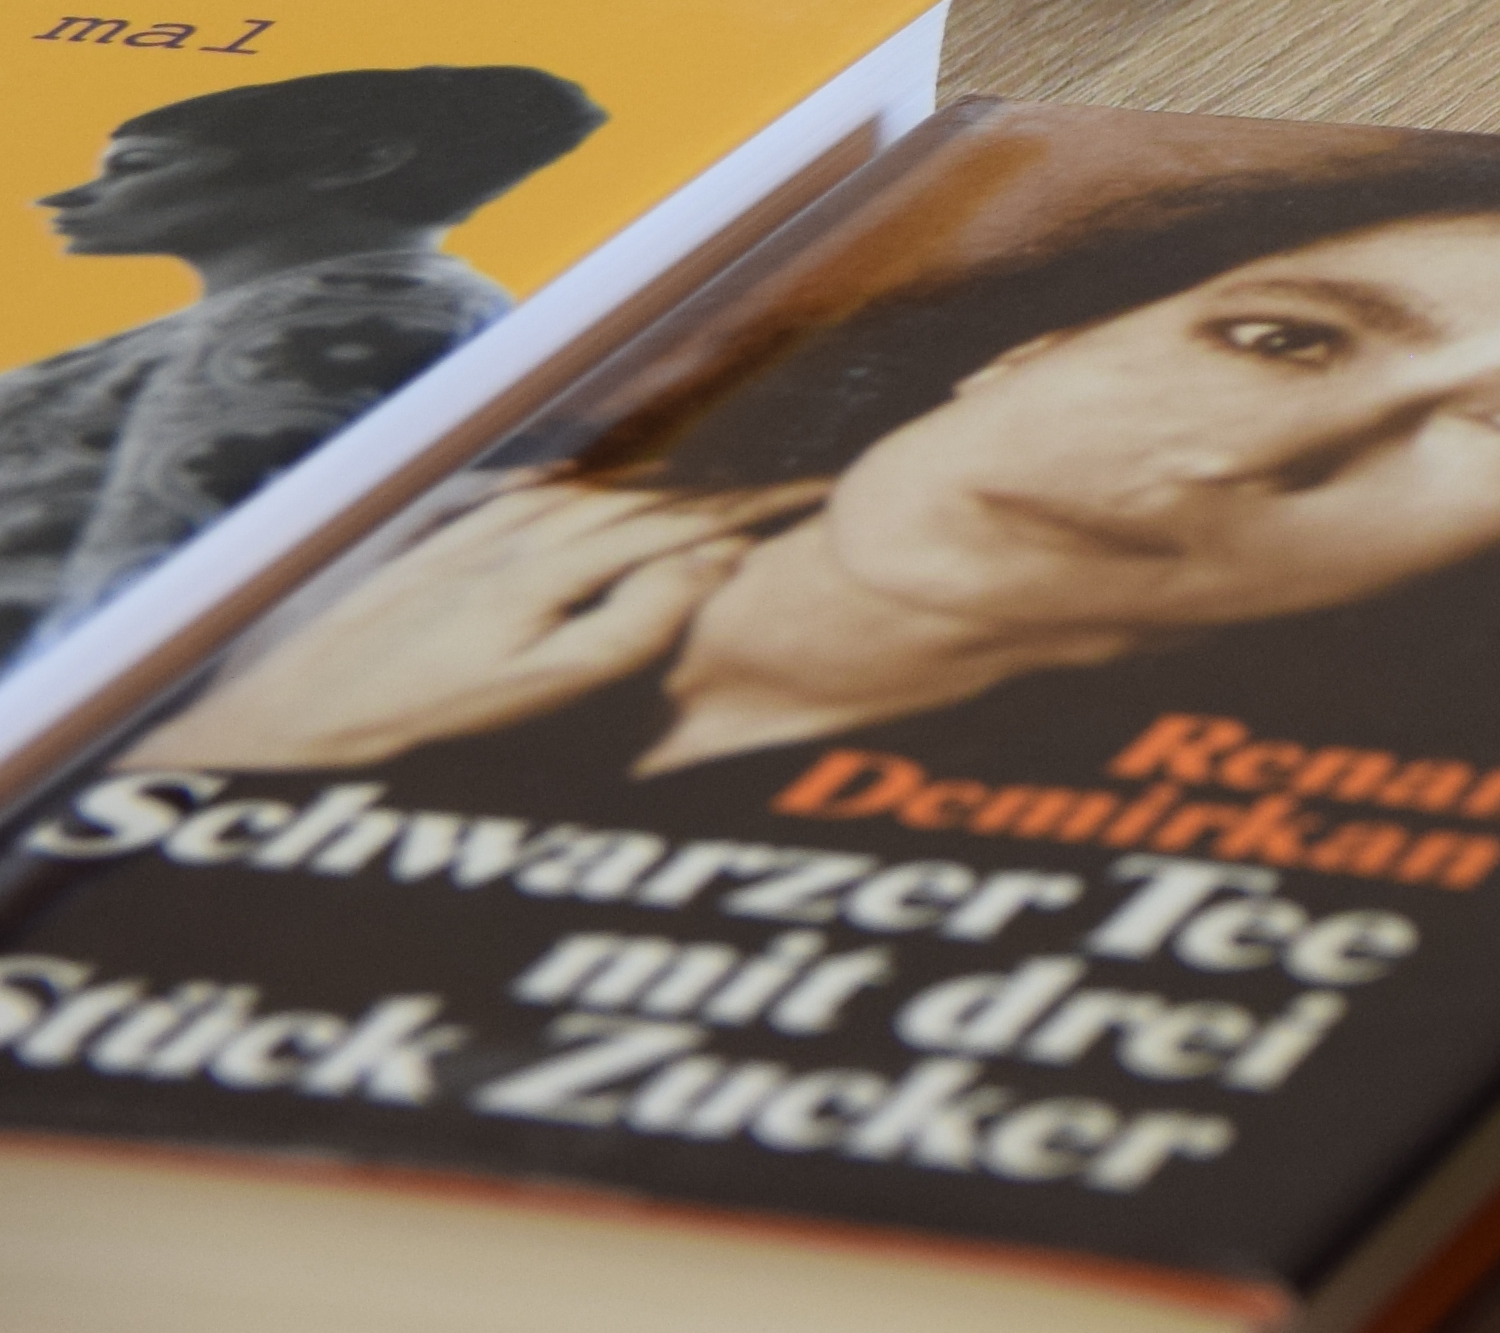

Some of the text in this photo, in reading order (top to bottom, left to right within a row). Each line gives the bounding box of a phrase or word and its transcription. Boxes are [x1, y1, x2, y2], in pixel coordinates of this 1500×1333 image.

[31, 16, 276, 54] mal
[46, 770, 1421, 985] Schwarzer Tee
[0, 956, 1235, 1191] Stück Zucker
[515, 928, 1344, 1091] mit drei
